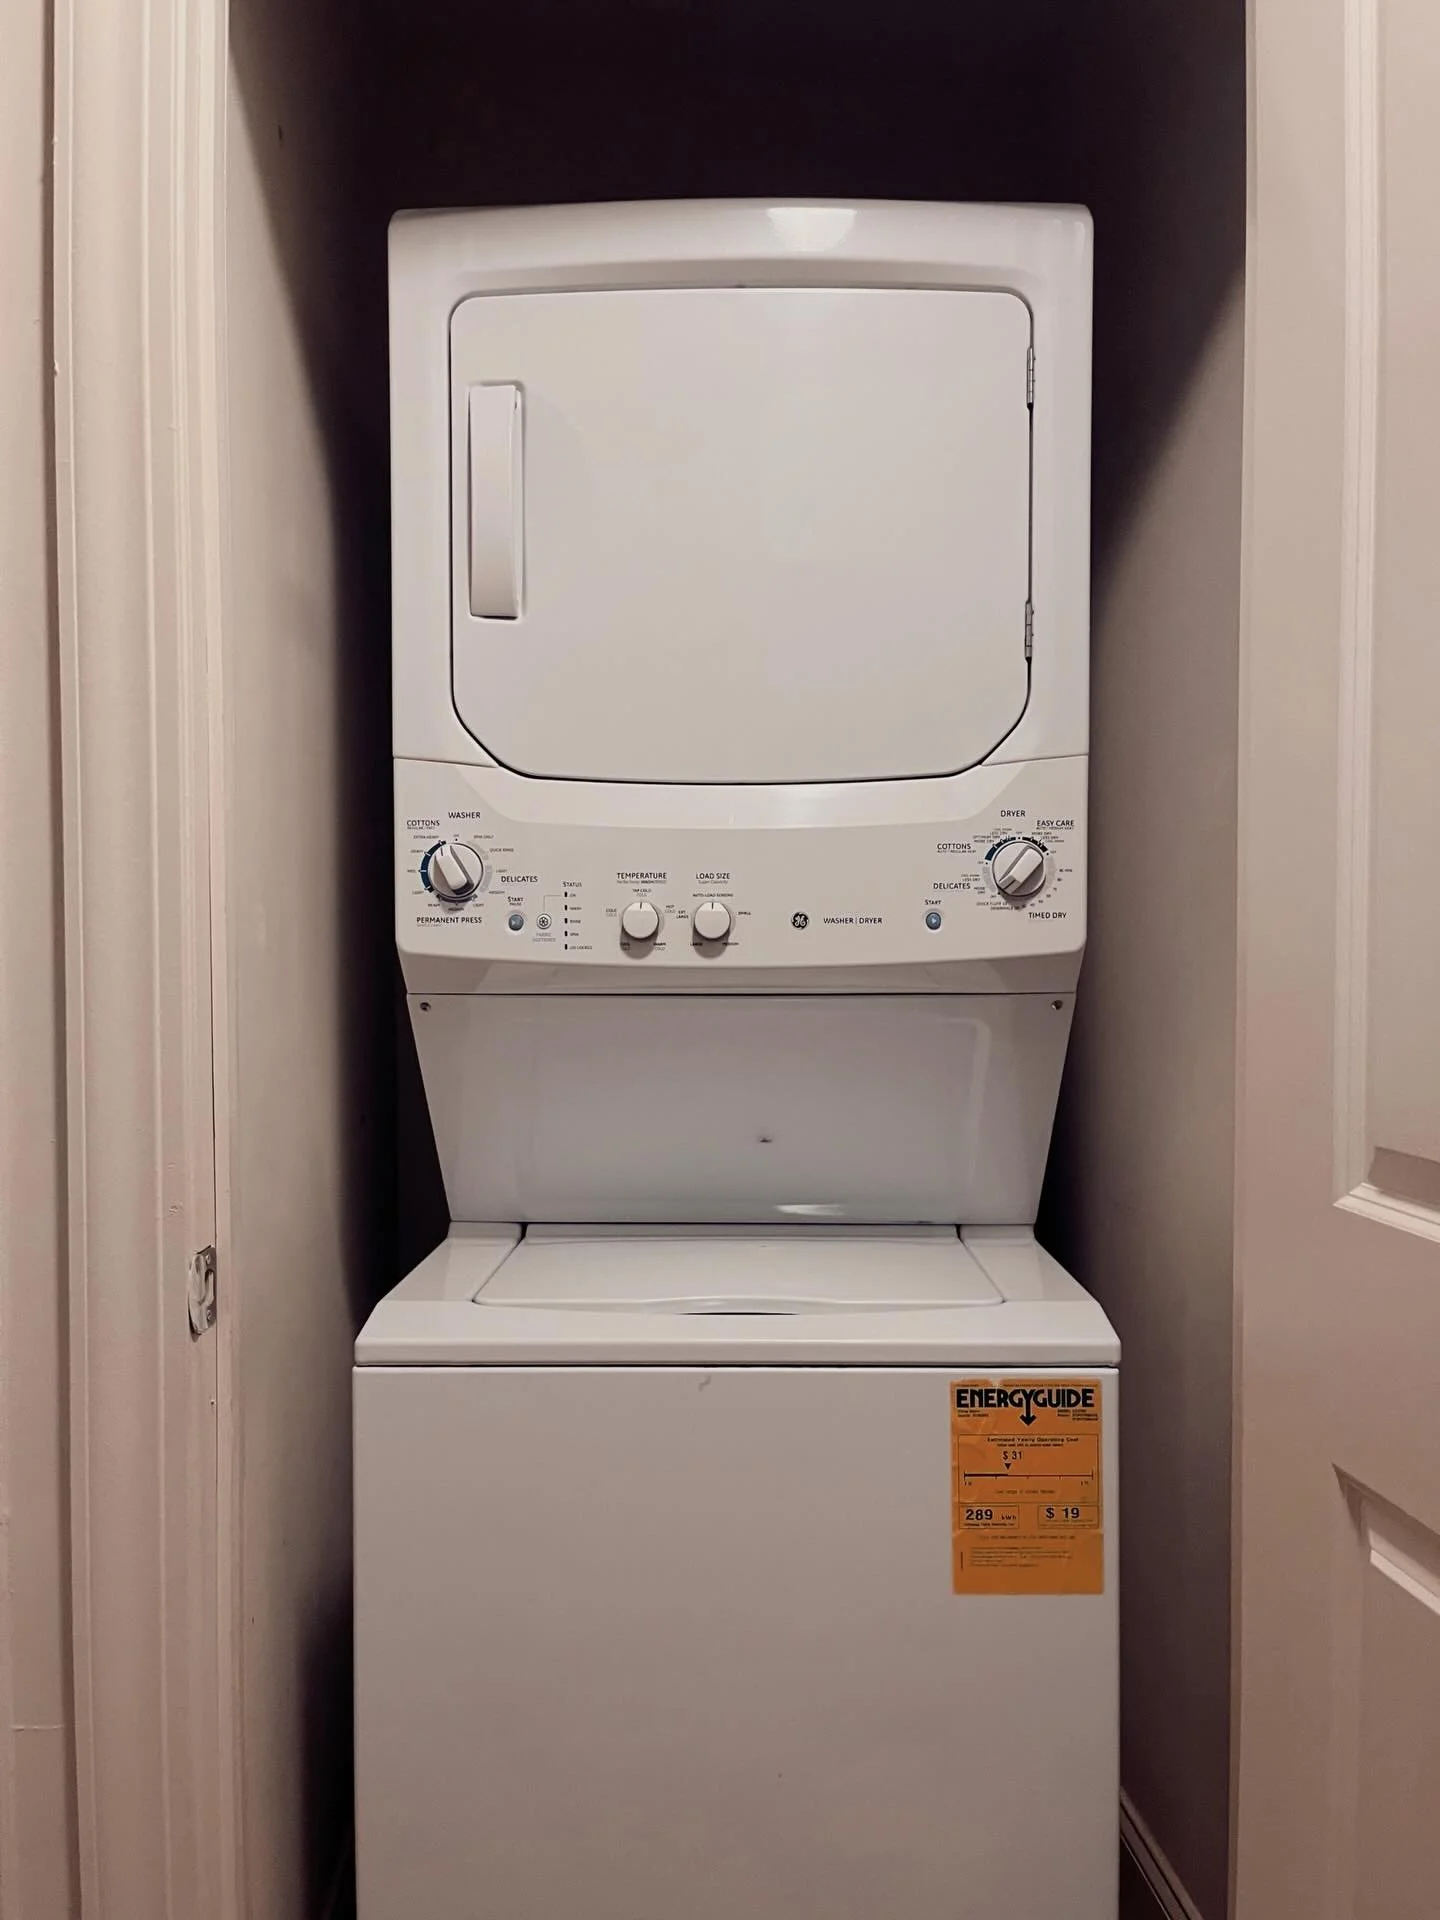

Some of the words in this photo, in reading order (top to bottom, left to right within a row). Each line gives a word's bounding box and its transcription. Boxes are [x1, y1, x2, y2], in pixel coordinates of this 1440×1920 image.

[448, 811, 481, 819] WASHER
[406, 819, 440, 827] COTTONS
[696, 872, 715, 880] LOAD
[716, 872, 730, 880] SIZE
[956, 1388, 1095, 1410] ENERGYGUIDE
[1012, 1451, 1023, 1460] 31
[965, 1508, 993, 1521] 289
[1046, 1507, 1055, 1519] $
[1062, 1507, 1080, 1519] 19
